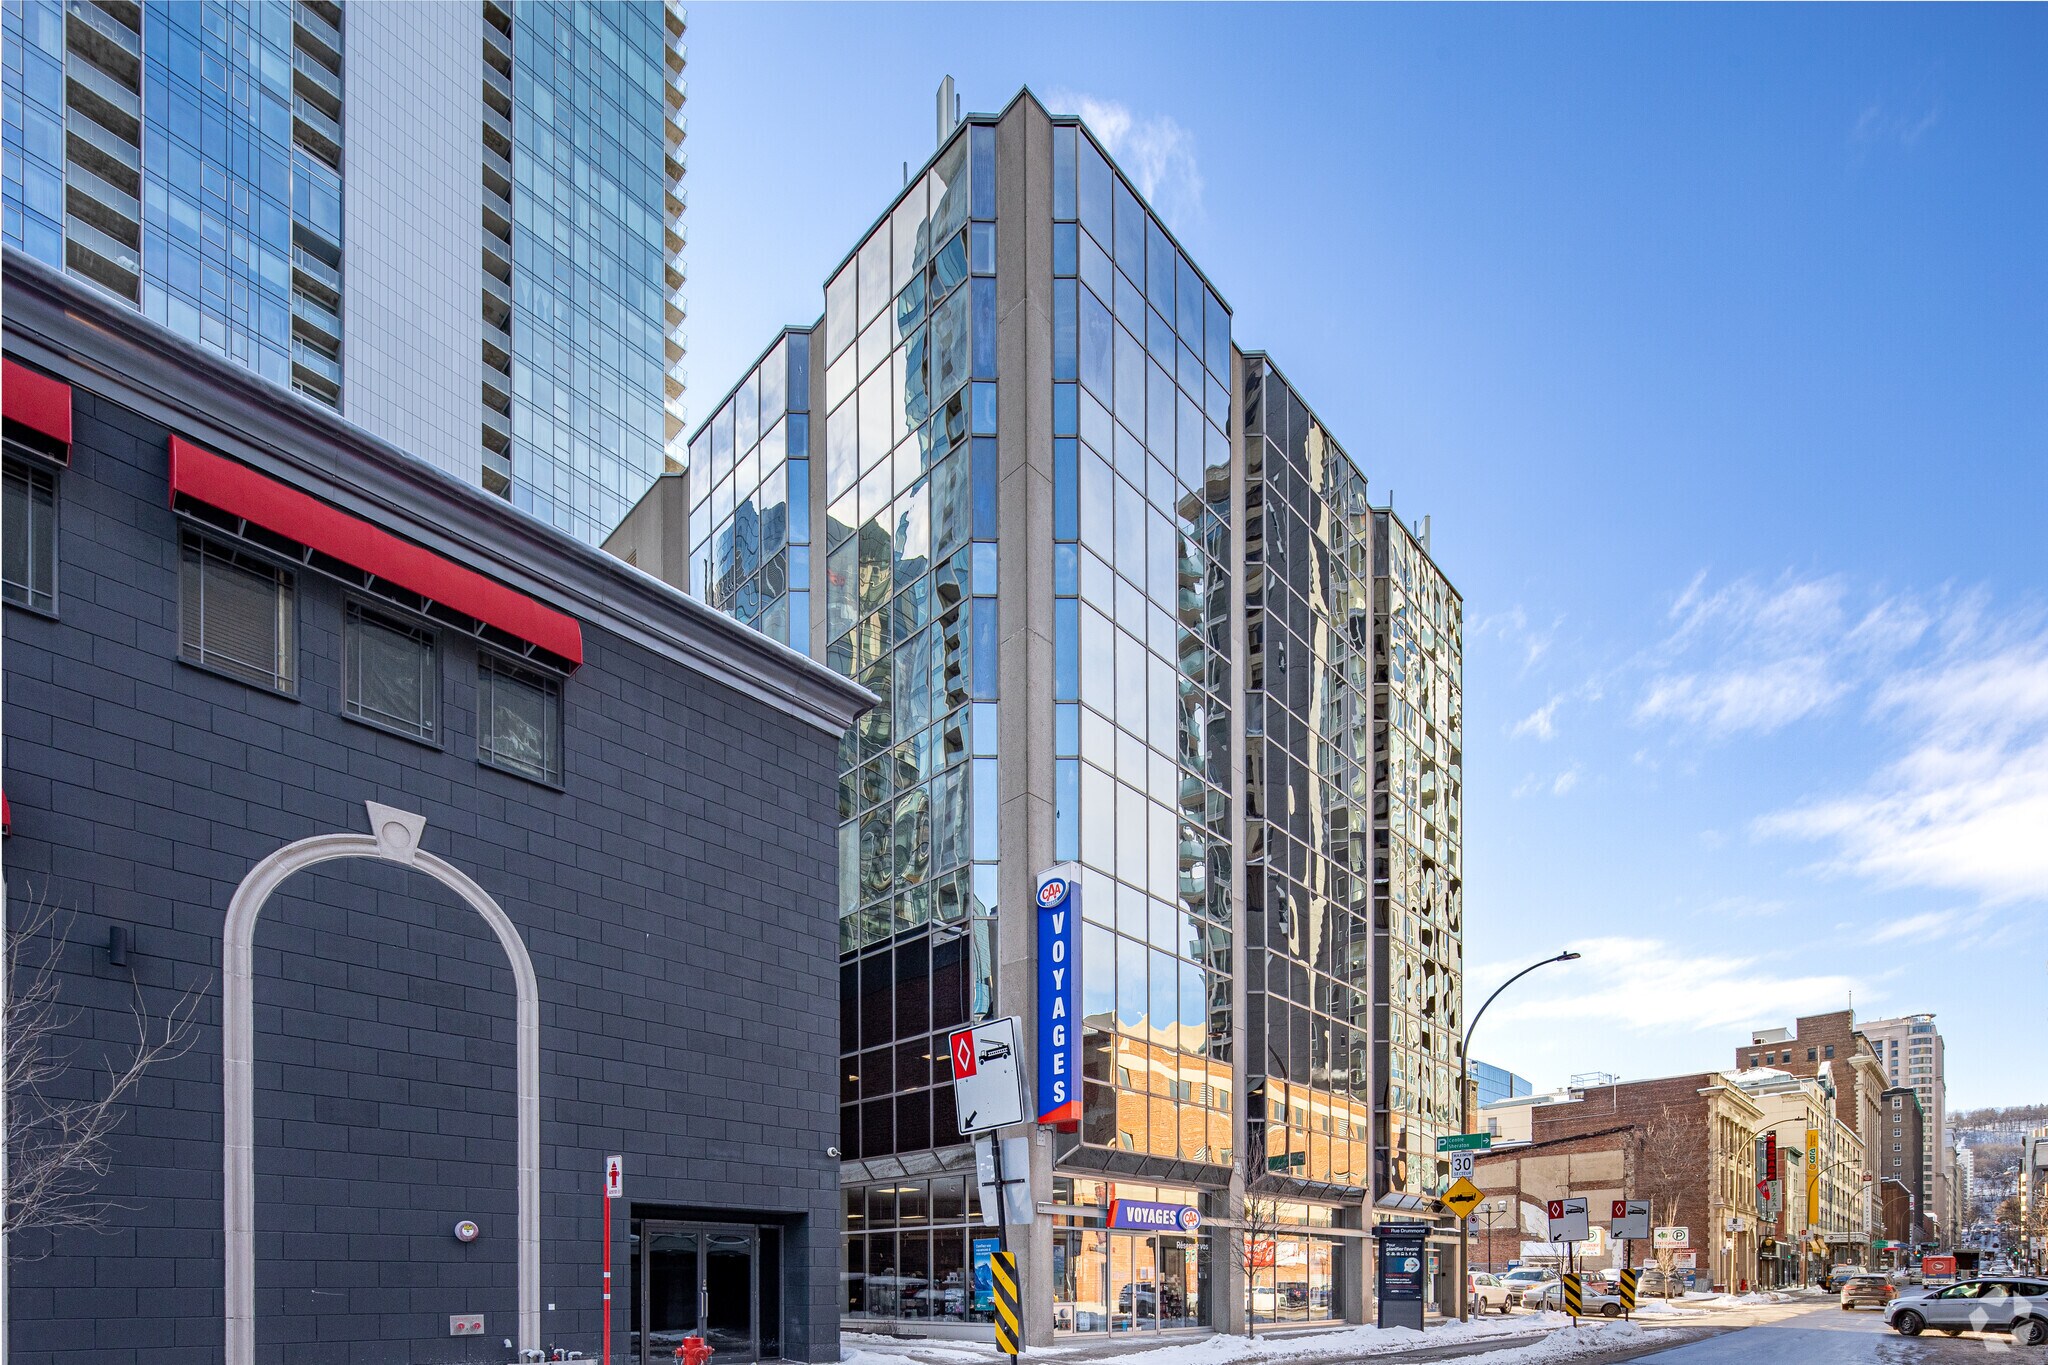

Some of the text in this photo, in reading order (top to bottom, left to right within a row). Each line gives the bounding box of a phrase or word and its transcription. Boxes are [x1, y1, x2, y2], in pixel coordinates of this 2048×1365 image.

[1042, 883, 1061, 901] CAA
[1052, 911, 1066, 1103] VOYAGES
[1454, 1157, 1471, 1172] 30
[1126, 1206, 1177, 1226] VOYAGES
[1185, 1211, 1198, 1226] CAA
